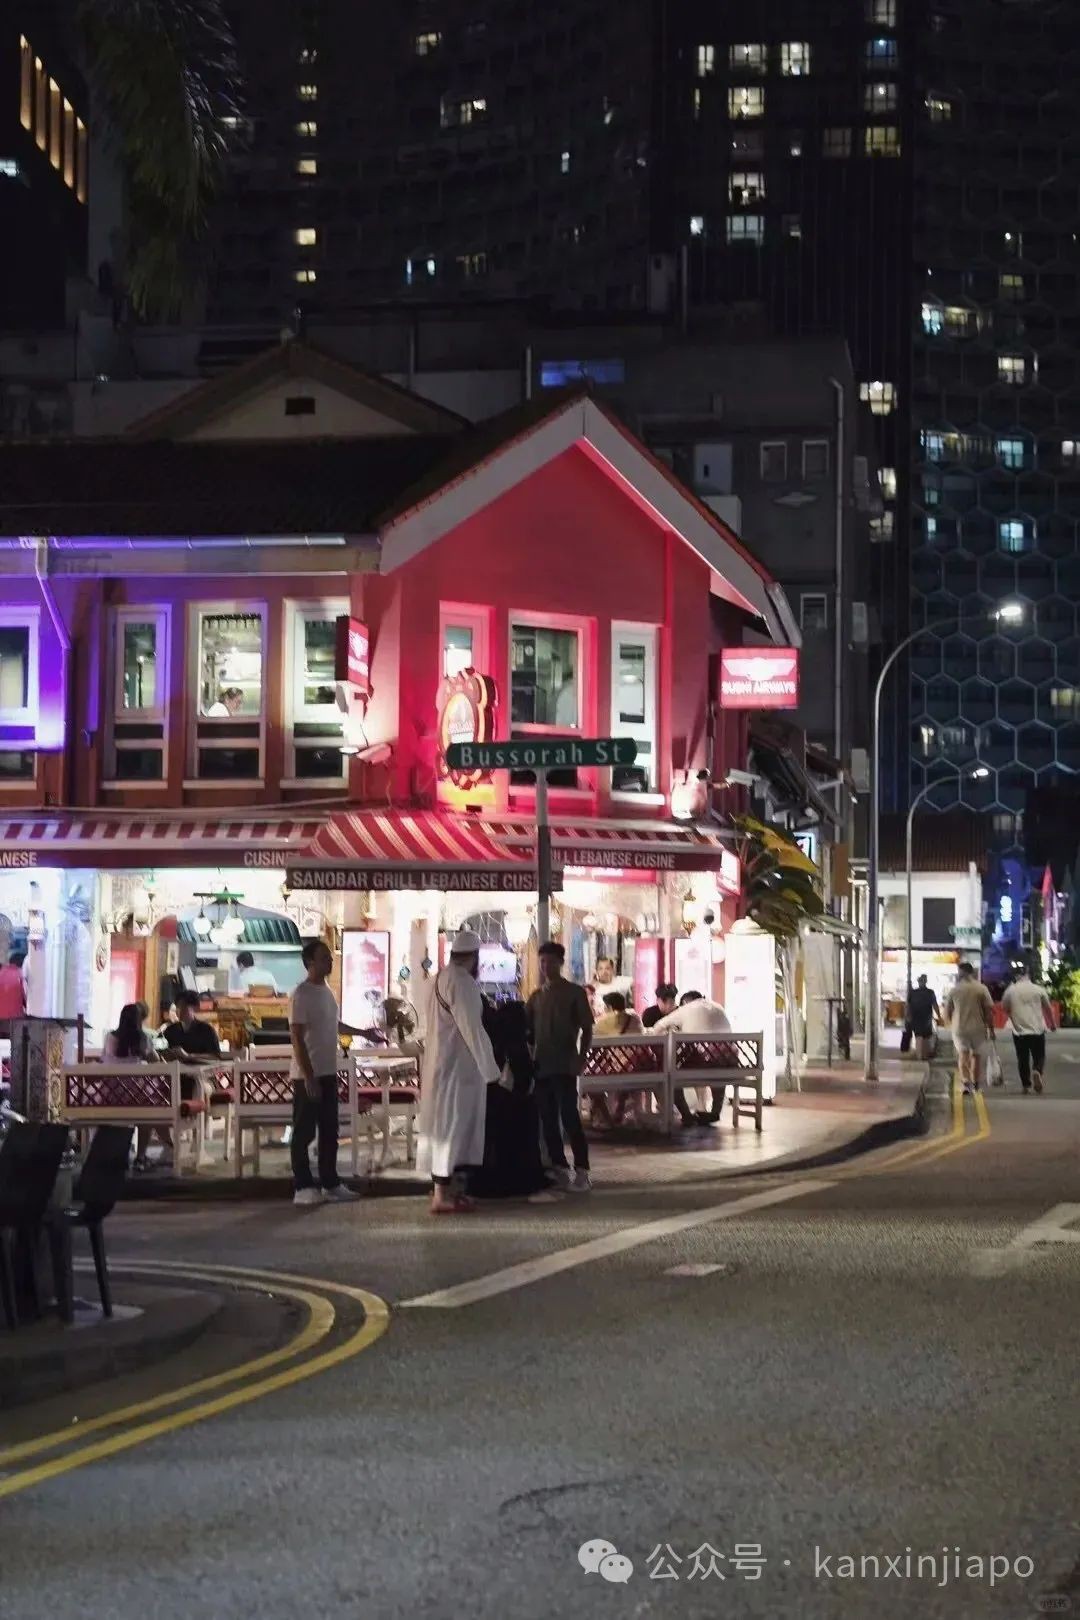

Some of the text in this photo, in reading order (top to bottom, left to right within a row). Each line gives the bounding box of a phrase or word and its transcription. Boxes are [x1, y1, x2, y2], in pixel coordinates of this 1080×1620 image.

[461, 741, 621, 767] Bussorah St
[573, 850, 631, 866] LEBANESE
[634, 854, 675, 869] CUSINE
[292, 871, 560, 889] SANOBAR GRILL LEBANESE CUSIE
